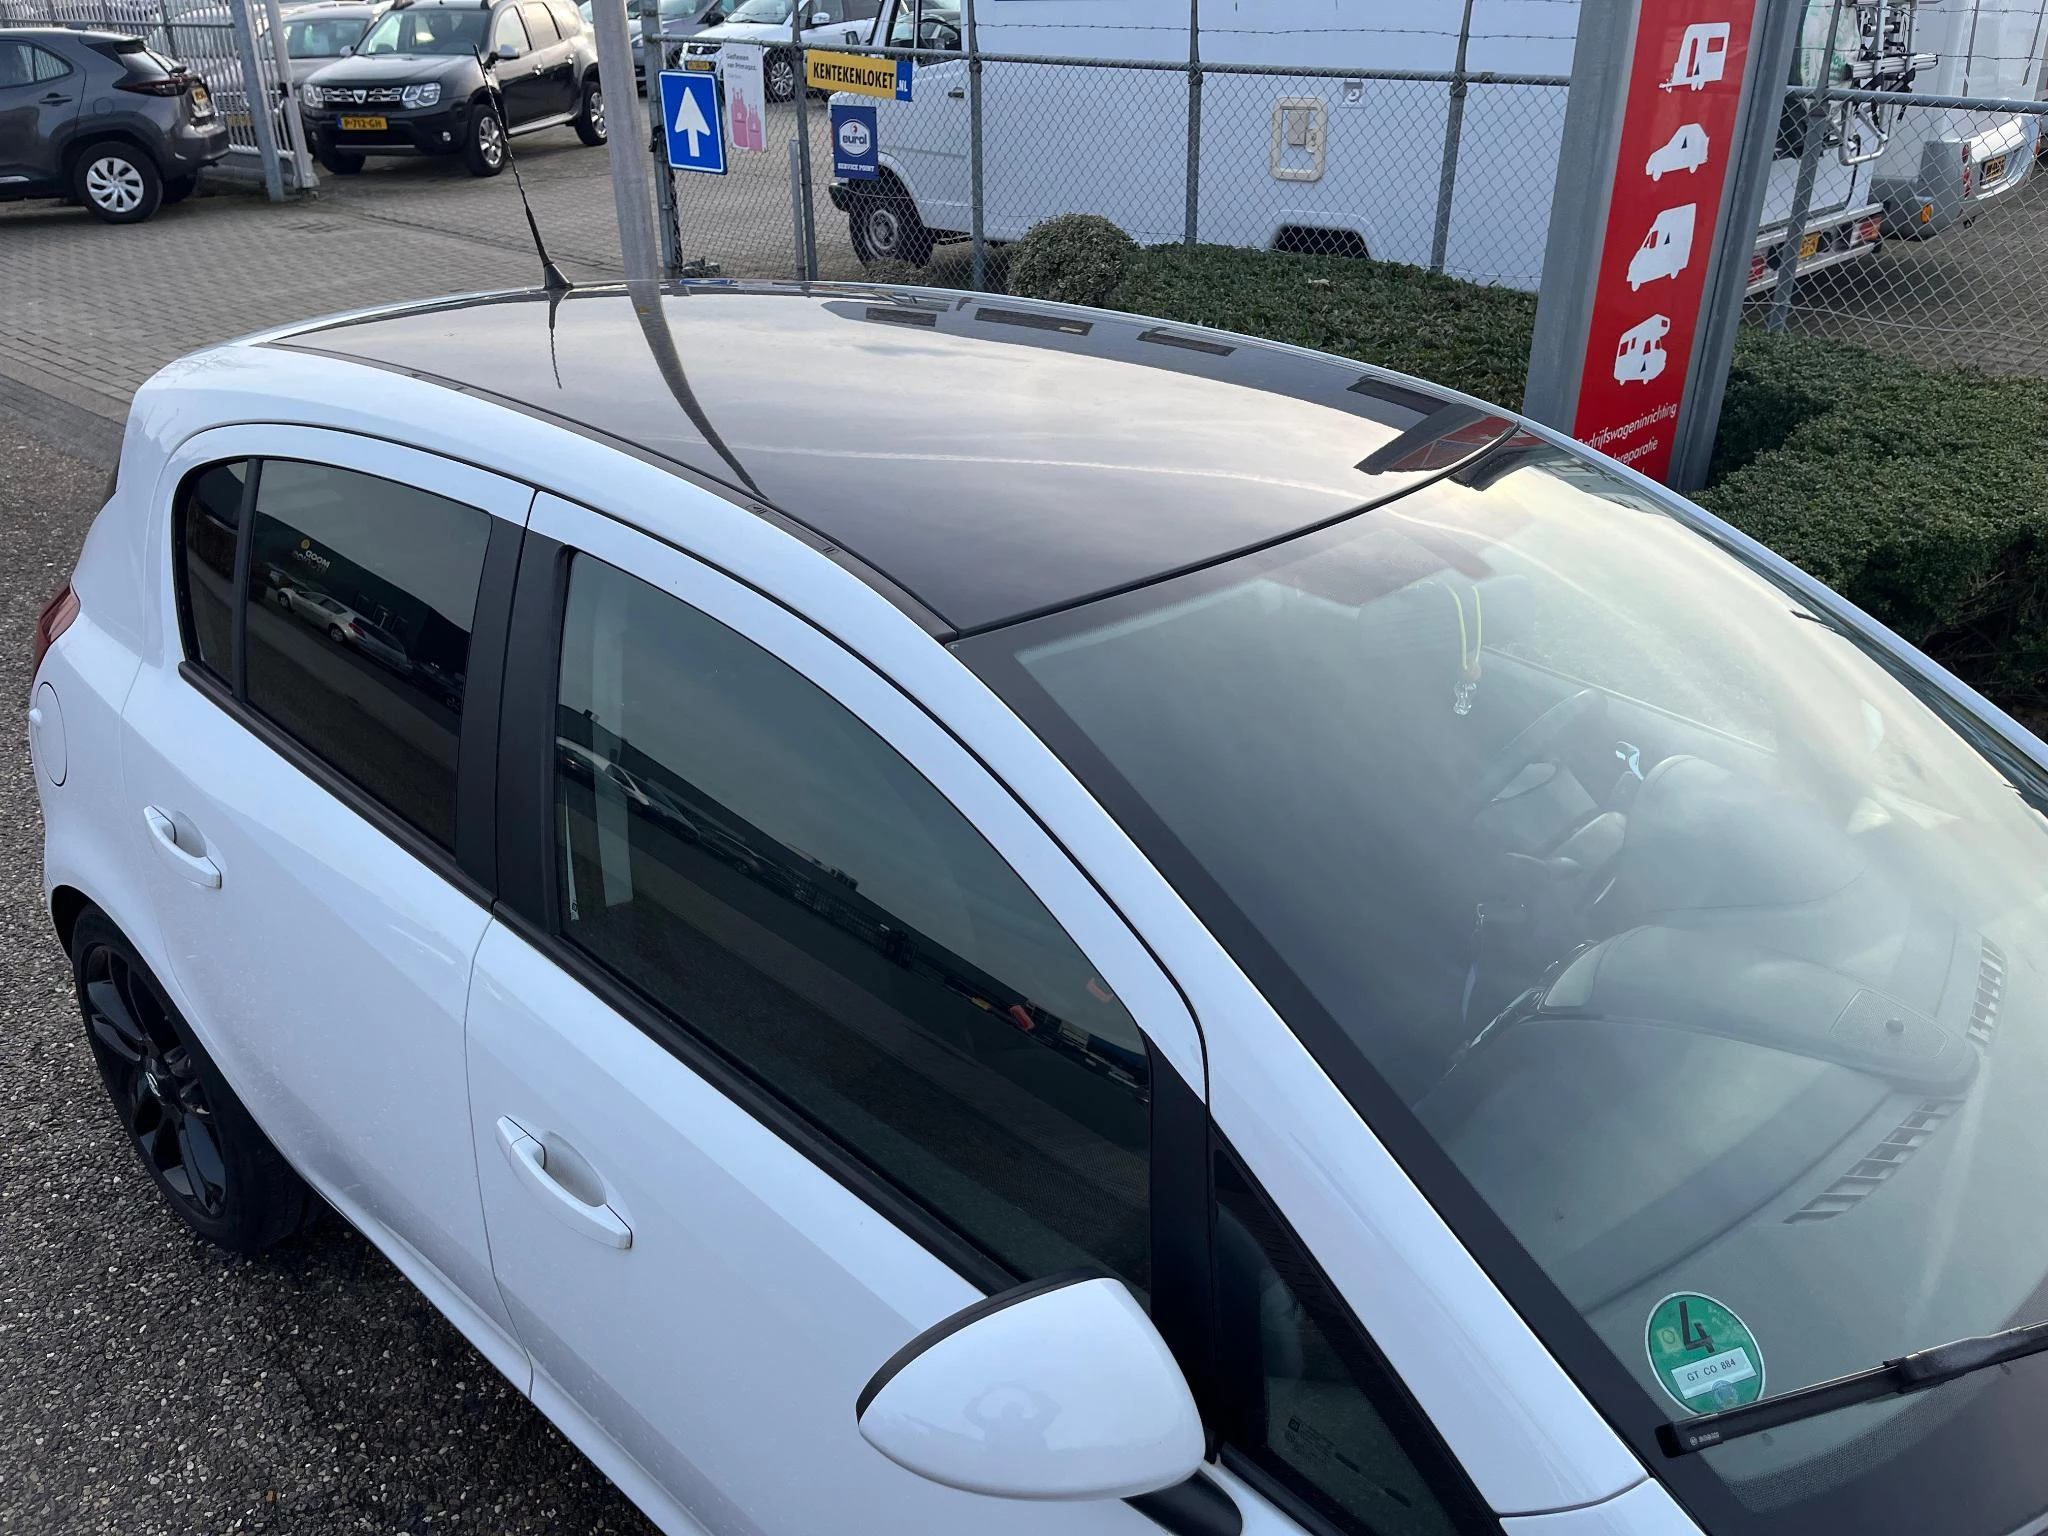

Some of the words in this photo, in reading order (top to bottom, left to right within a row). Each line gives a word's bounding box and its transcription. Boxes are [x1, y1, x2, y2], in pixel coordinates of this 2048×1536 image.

[813, 62, 895, 90] KENTEKENLOKET
[842, 134, 867, 144] eurol
[1679, 1301, 1715, 1353] 4
[1686, 1371, 1700, 1382] GT
[1703, 1364, 1718, 1376] CO
[1720, 1358, 1736, 1370] 884
